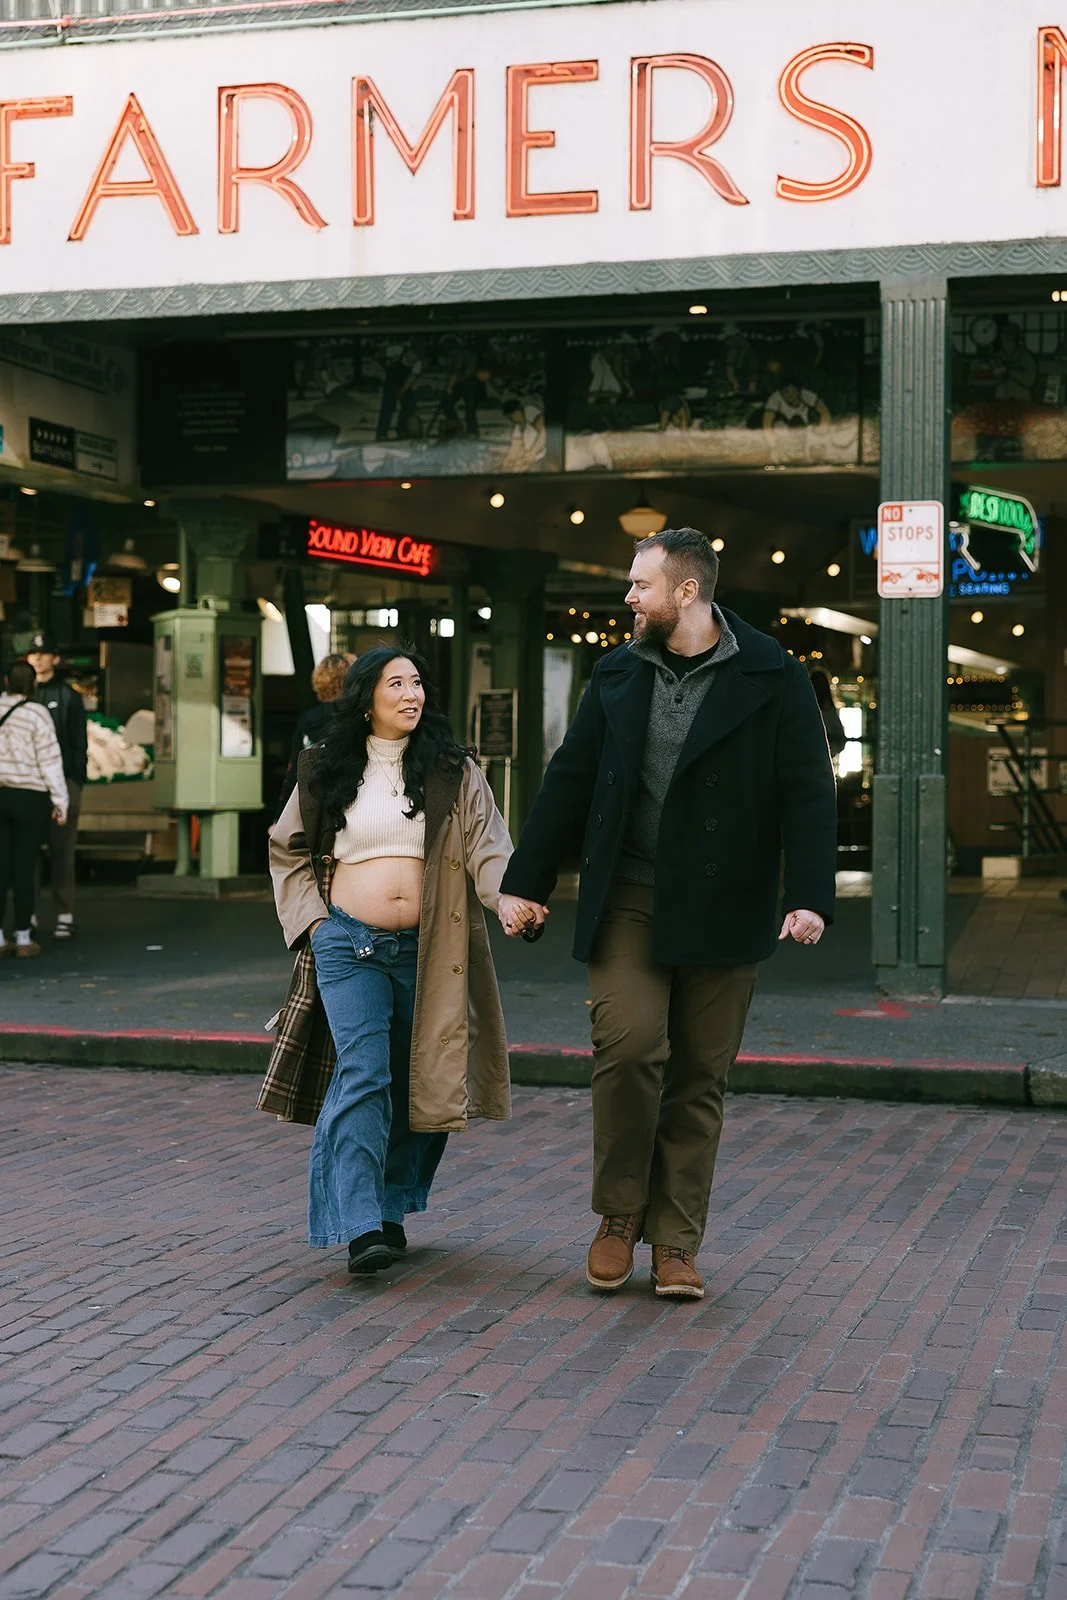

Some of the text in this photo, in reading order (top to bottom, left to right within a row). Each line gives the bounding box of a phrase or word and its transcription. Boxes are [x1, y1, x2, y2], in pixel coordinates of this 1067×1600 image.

[0, 42, 875, 245] FARMERS
[883, 507, 901, 521] NO
[360, 529, 397, 559] VIEW
[888, 526, 934, 541] STOPS
